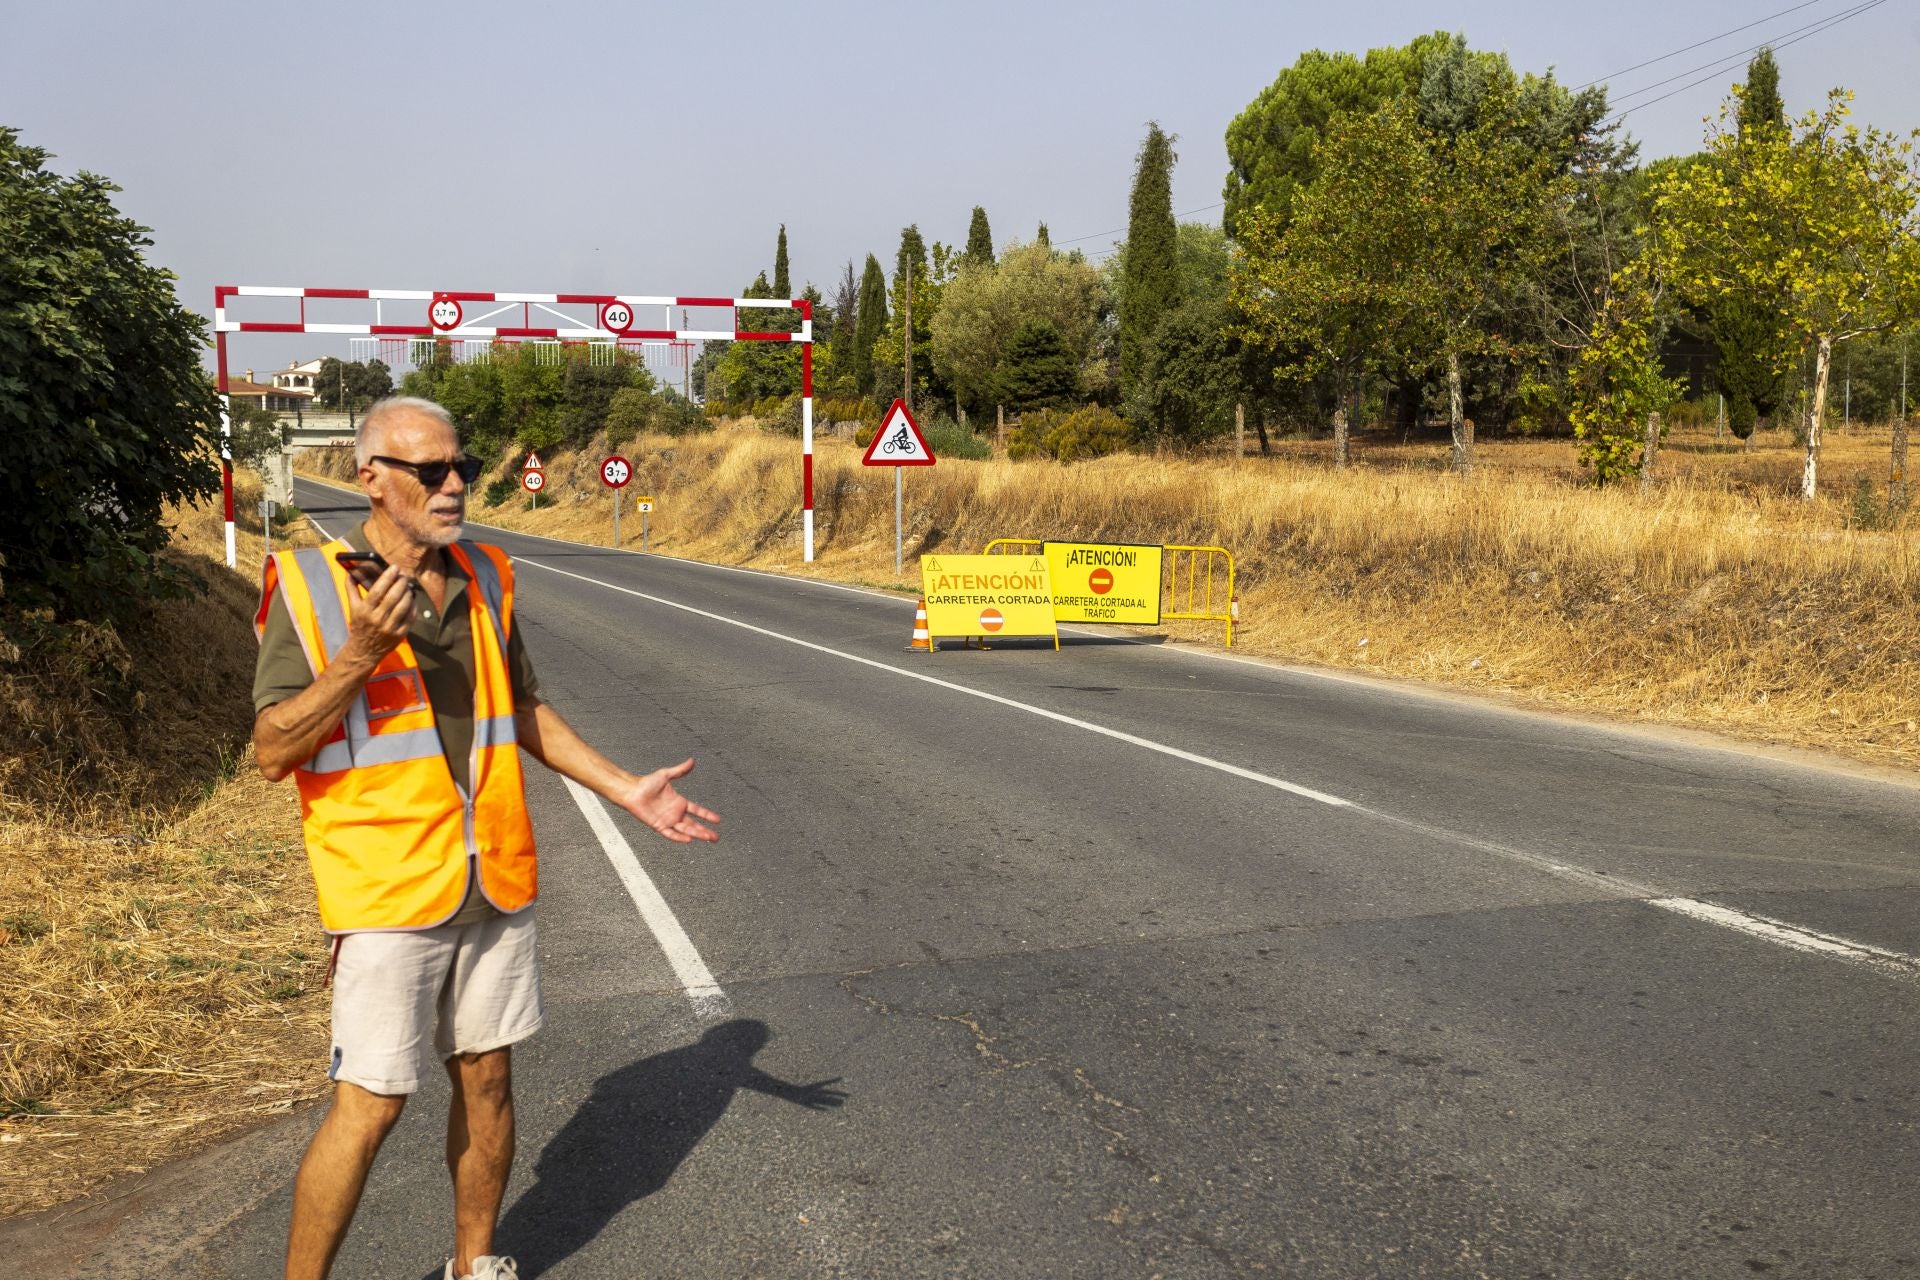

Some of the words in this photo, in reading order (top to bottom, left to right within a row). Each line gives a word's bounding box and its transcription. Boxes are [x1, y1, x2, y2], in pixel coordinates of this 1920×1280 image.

[435, 309, 447, 317] 3,7
[608, 311, 628, 323] 40
[527, 477, 541, 485] 40
[643, 503, 649, 511] 2
[1066, 547, 1137, 568] ¡ATENCIÓN!
[932, 571, 1044, 593] ¡ATENCIÓN!
[927, 595, 996, 605] CARRETERA
[998, 595, 1051, 605] CORTADA
[1053, 596, 1099, 607] CARRETERA
[1100, 597, 1136, 608] CORTADA
[1136, 599, 1147, 609] AL
[1084, 606, 1116, 619] TRÁFICO
